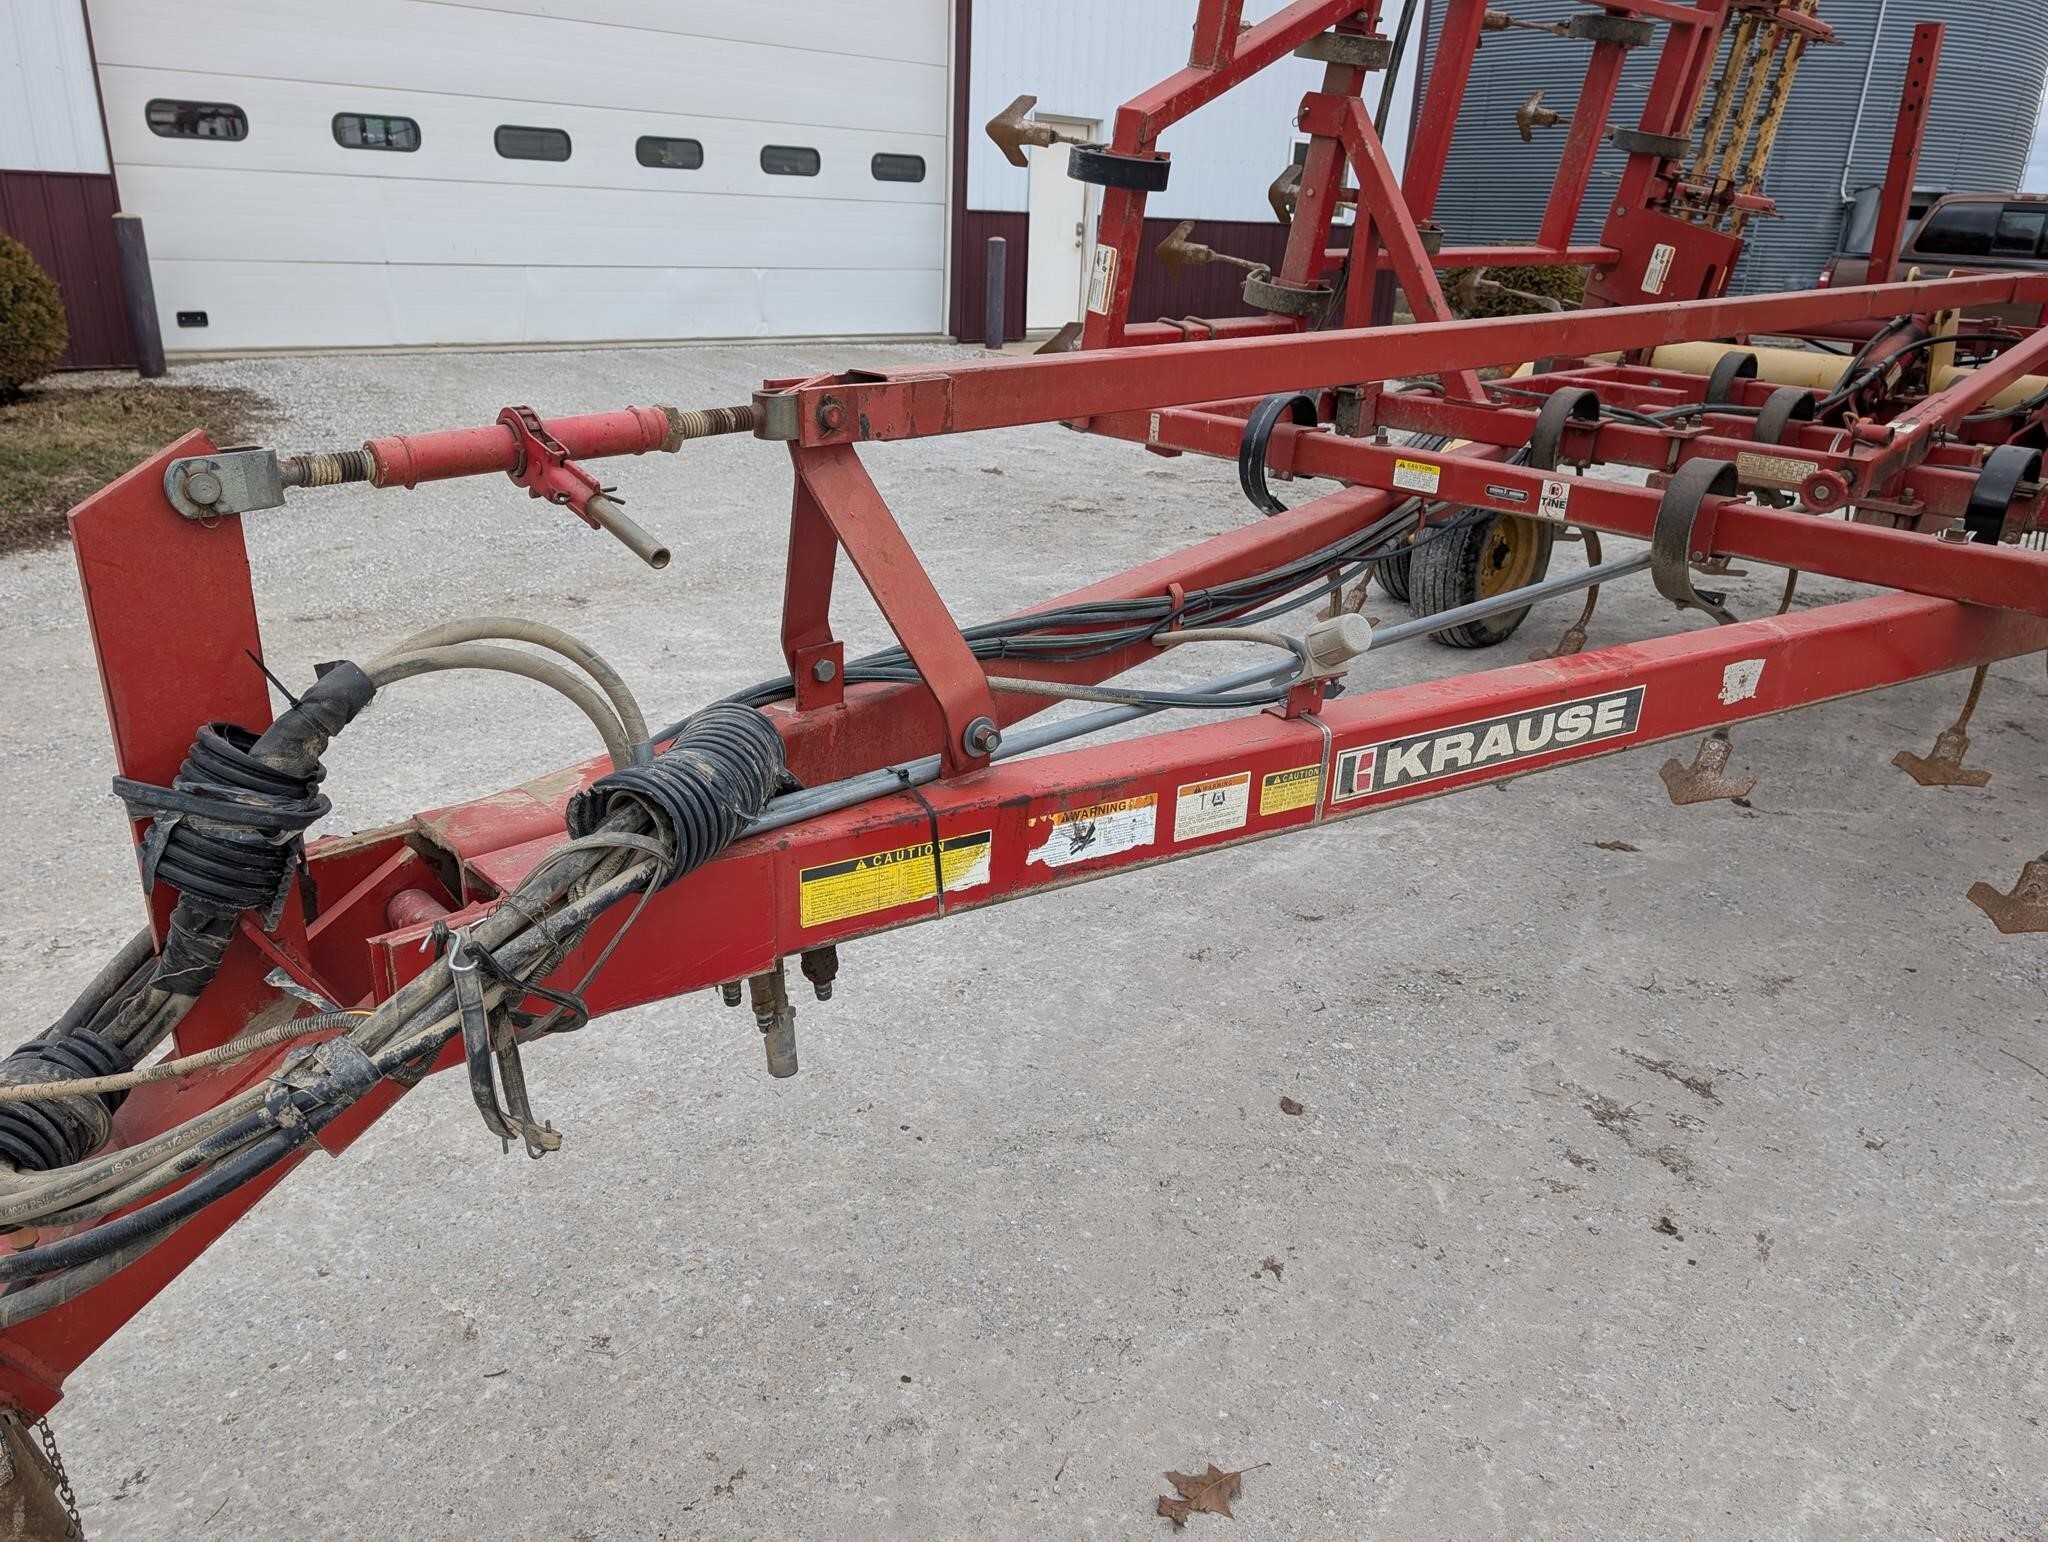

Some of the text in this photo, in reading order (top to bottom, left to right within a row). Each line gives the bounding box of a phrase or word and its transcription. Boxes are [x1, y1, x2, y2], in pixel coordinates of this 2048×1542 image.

[1542, 497, 1566, 509] TINE
[1384, 697, 1627, 785] KRAUSE
[1283, 768, 1319, 782] CAUTION
[1203, 780, 1234, 791] WARNING
[1070, 801, 1127, 822] WARNING
[873, 842, 945, 866] CAUTION
